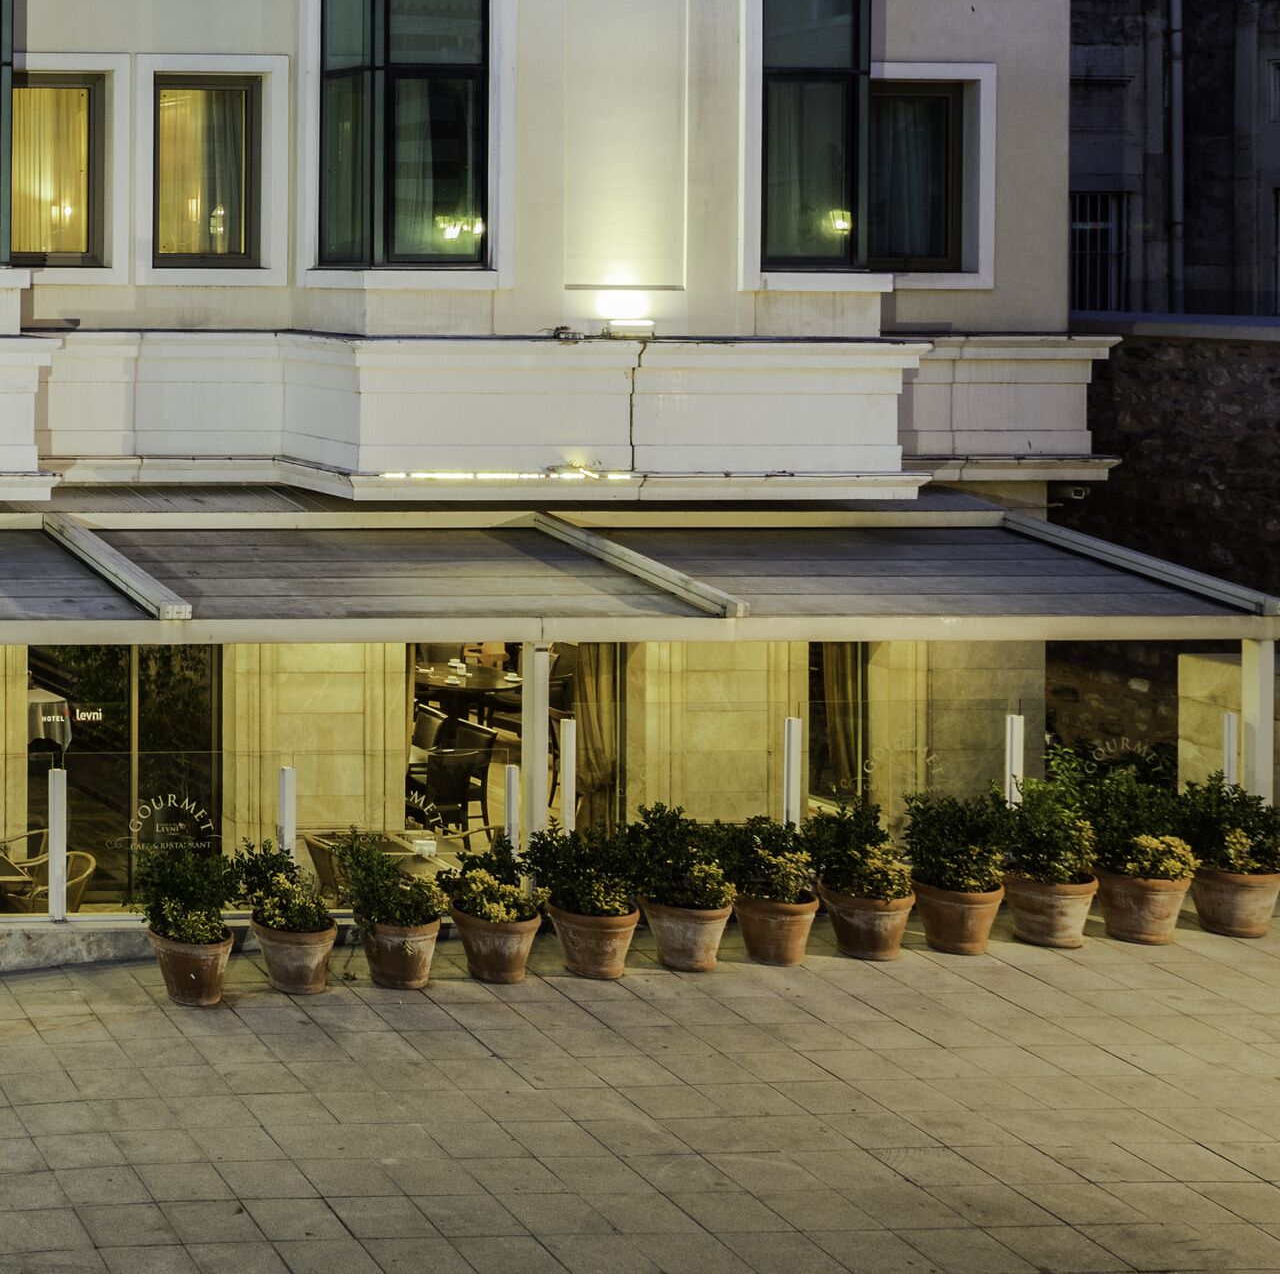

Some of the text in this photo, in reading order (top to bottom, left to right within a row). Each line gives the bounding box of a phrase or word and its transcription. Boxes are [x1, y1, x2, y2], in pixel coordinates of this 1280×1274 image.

[75, 708, 102, 721] levni
[1084, 737, 1164, 774] GOURMET
[129, 794, 215, 832] GOURMET
